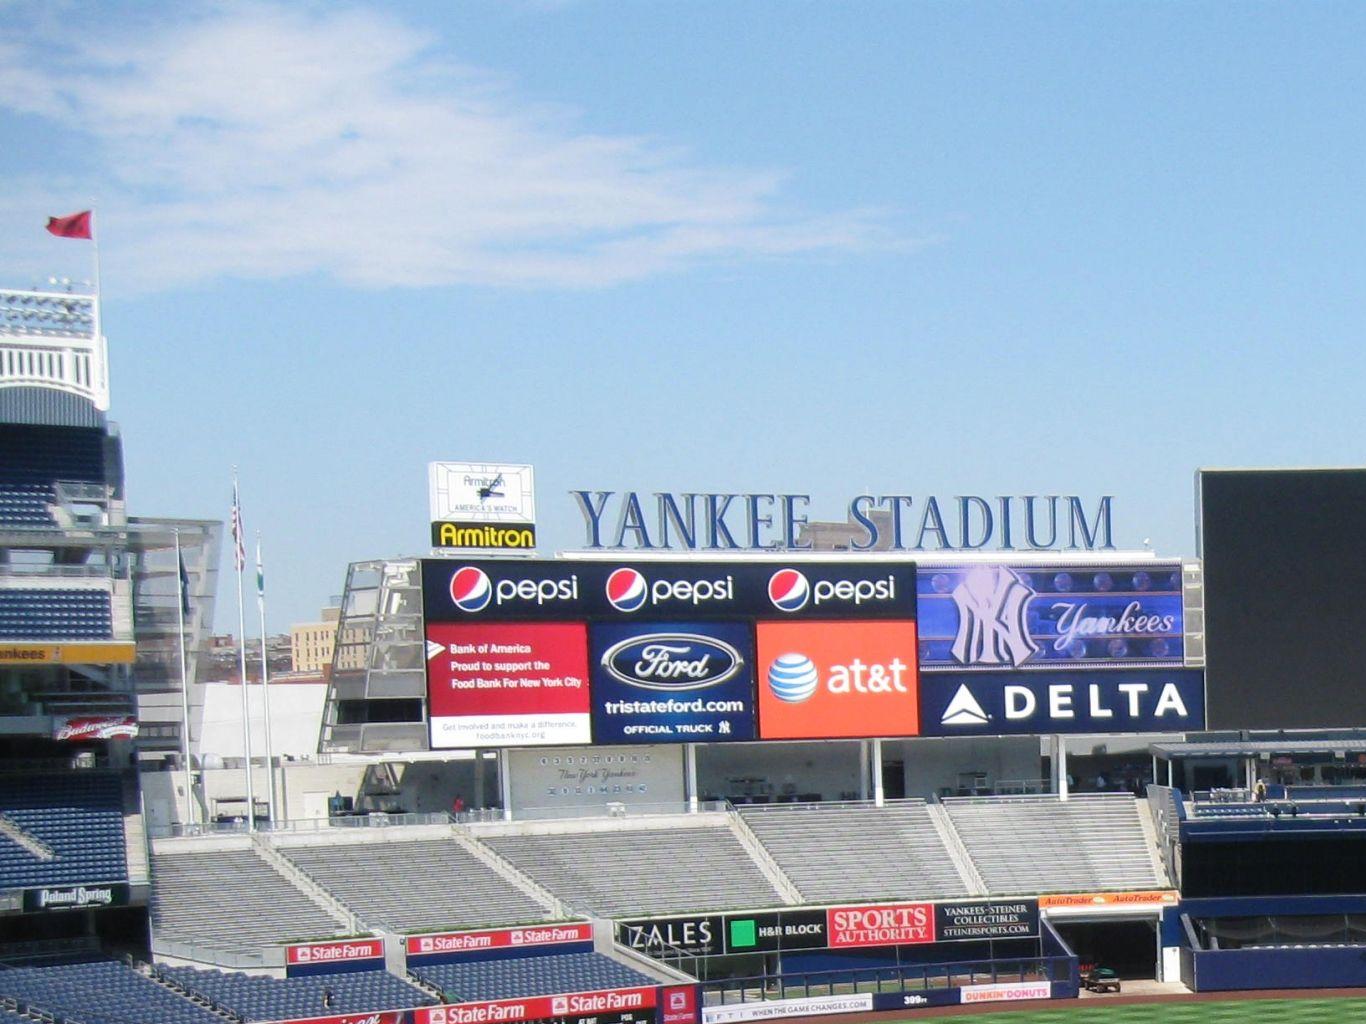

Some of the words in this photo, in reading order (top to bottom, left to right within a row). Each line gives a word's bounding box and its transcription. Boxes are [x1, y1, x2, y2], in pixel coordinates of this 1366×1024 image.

[570, 490, 815, 550] YANKEE
[849, 495, 1116, 550] STADIUM
[440, 523, 534, 548] Armitron
[496, 575, 578, 605] pepsi
[651, 576, 733, 605] pepsi
[814, 575, 895, 605] pepsi
[1050, 600, 1175, 652] Yankees
[450, 644, 476, 654] Bank
[478, 644, 489, 653] of
[491, 644, 532, 654] America
[450, 662, 480, 671] Proud
[482, 662, 492, 670] to
[494, 662, 532, 672] support
[534, 661, 550, 670] the
[634, 644, 711, 678] Ford
[451, 679, 476, 689] Food
[477, 678, 501, 688] Bank
[503, 678, 518, 687] For
[520, 678, 543, 688] New
[543, 678, 563, 687] York
[564, 676, 582, 688] City
[826, 657, 908, 694] at&t
[605, 699, 744, 714] tristateford.com
[1004, 682, 1189, 720] DELTA
[623, 725, 673, 734] OFFICIAL
[675, 724, 713, 733] TRUCK
[78, 887, 112, 904] Spring
[1113, 895, 1161, 903] AutoTrader
[945, 904, 1028, 917] YANKEES-STEINER
[834, 907, 927, 931] SPORTS
[954, 914, 1019, 925] COLLECTIBLES
[525, 930, 551, 943] State
[551, 929, 579, 941] Farm
[632, 921, 712, 947] ZALES
[758, 927, 783, 937] H&R
[785, 924, 823, 935] BLOCK
[943, 925, 1030, 937] STEINERSPORTS.COM
[435, 936, 462, 949] State
[463, 935, 491, 947] Farm
[312, 945, 341, 959] State
[342, 943, 372, 957] Farm
[570, 996, 606, 1012] State
[607, 993, 642, 1009] Farm
[965, 990, 1006, 1001] DUNKIN'
[1007, 988, 1048, 998] DONUTS
[449, 1007, 486, 1024] State
[487, 1005, 525, 1021] Farm
[752, 1007, 773, 1017] WHEN
[774, 1005, 786, 1014] THE
[788, 1001, 810, 1013] GAME
